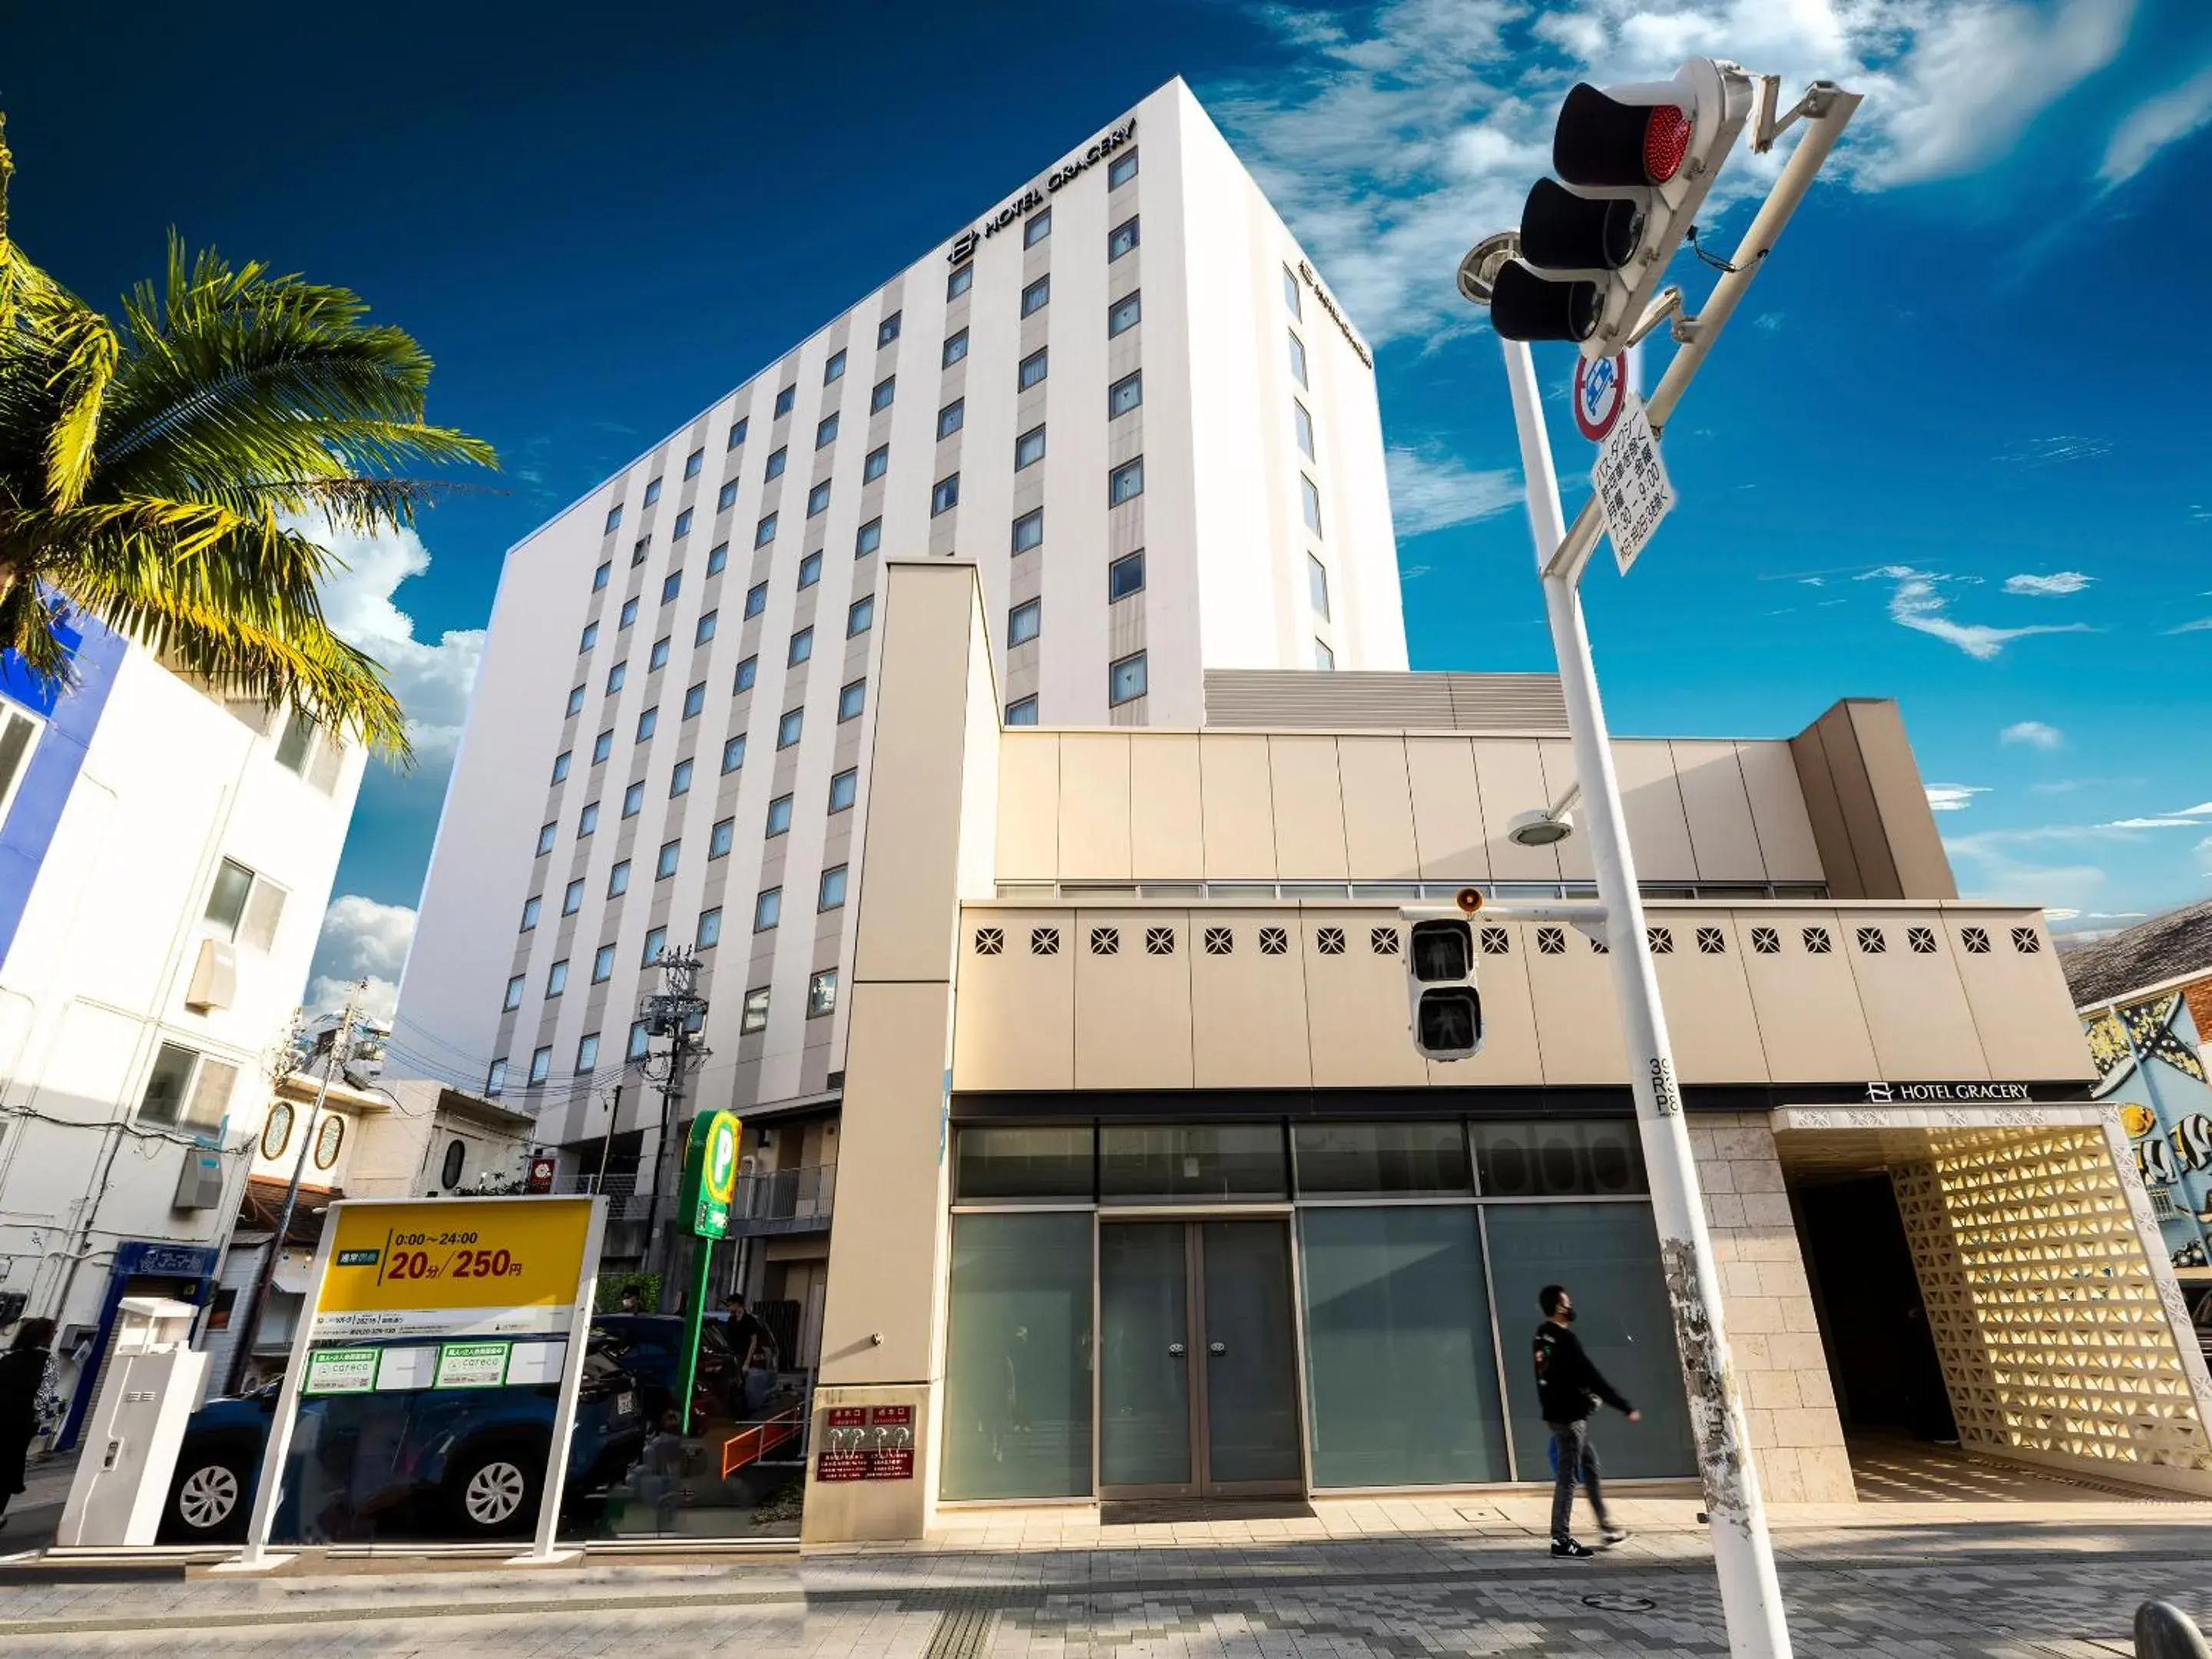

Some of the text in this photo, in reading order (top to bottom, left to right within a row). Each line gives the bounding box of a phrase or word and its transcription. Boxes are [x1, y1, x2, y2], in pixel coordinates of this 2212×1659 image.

[985, 117, 1137, 239] HOTEL GRACERY
[1900, 1084, 2028, 1100] HOTEL GRACERY
